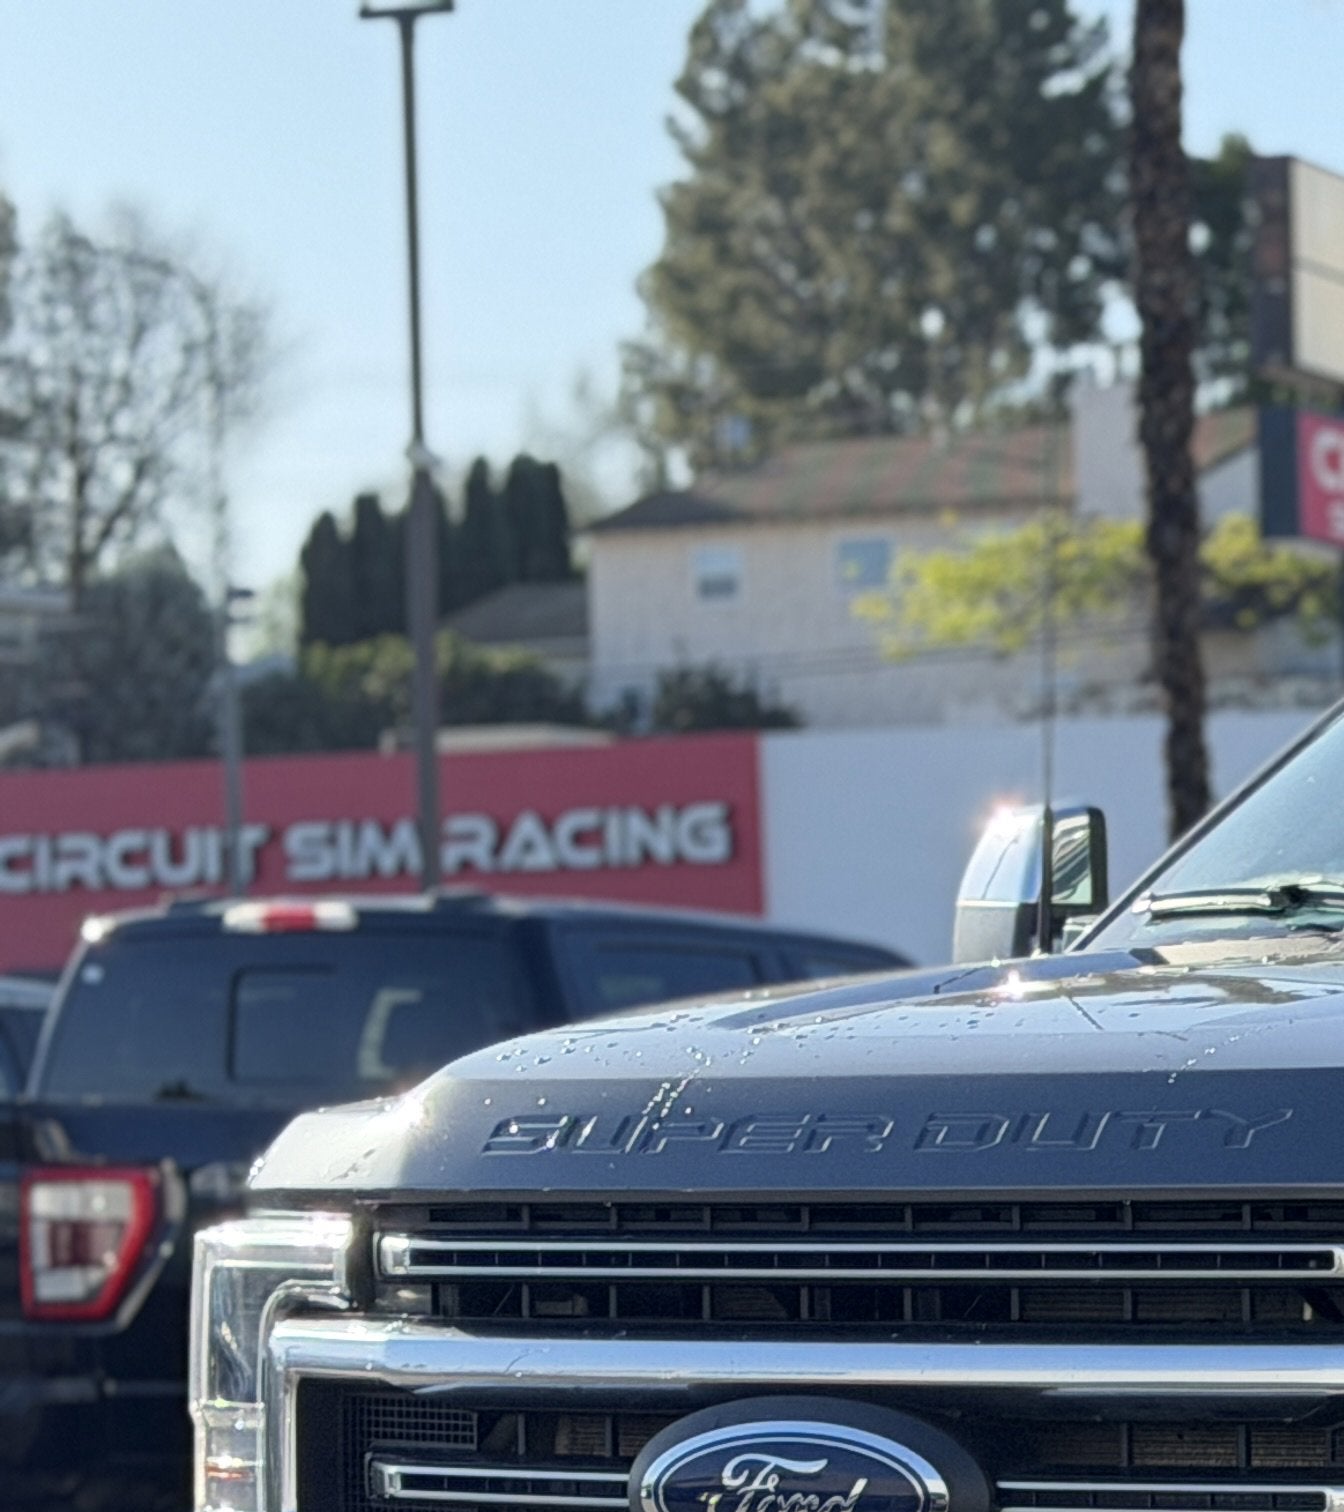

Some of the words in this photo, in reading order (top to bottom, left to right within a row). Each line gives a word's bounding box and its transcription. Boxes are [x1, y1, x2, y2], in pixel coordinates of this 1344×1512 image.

[0, 826, 269, 893] CIRCUIT
[281, 818, 420, 882] SIM
[441, 802, 732, 874] RACING
[481, 1110, 894, 1157] SUPER
[915, 1107, 1293, 1154] DUTY
